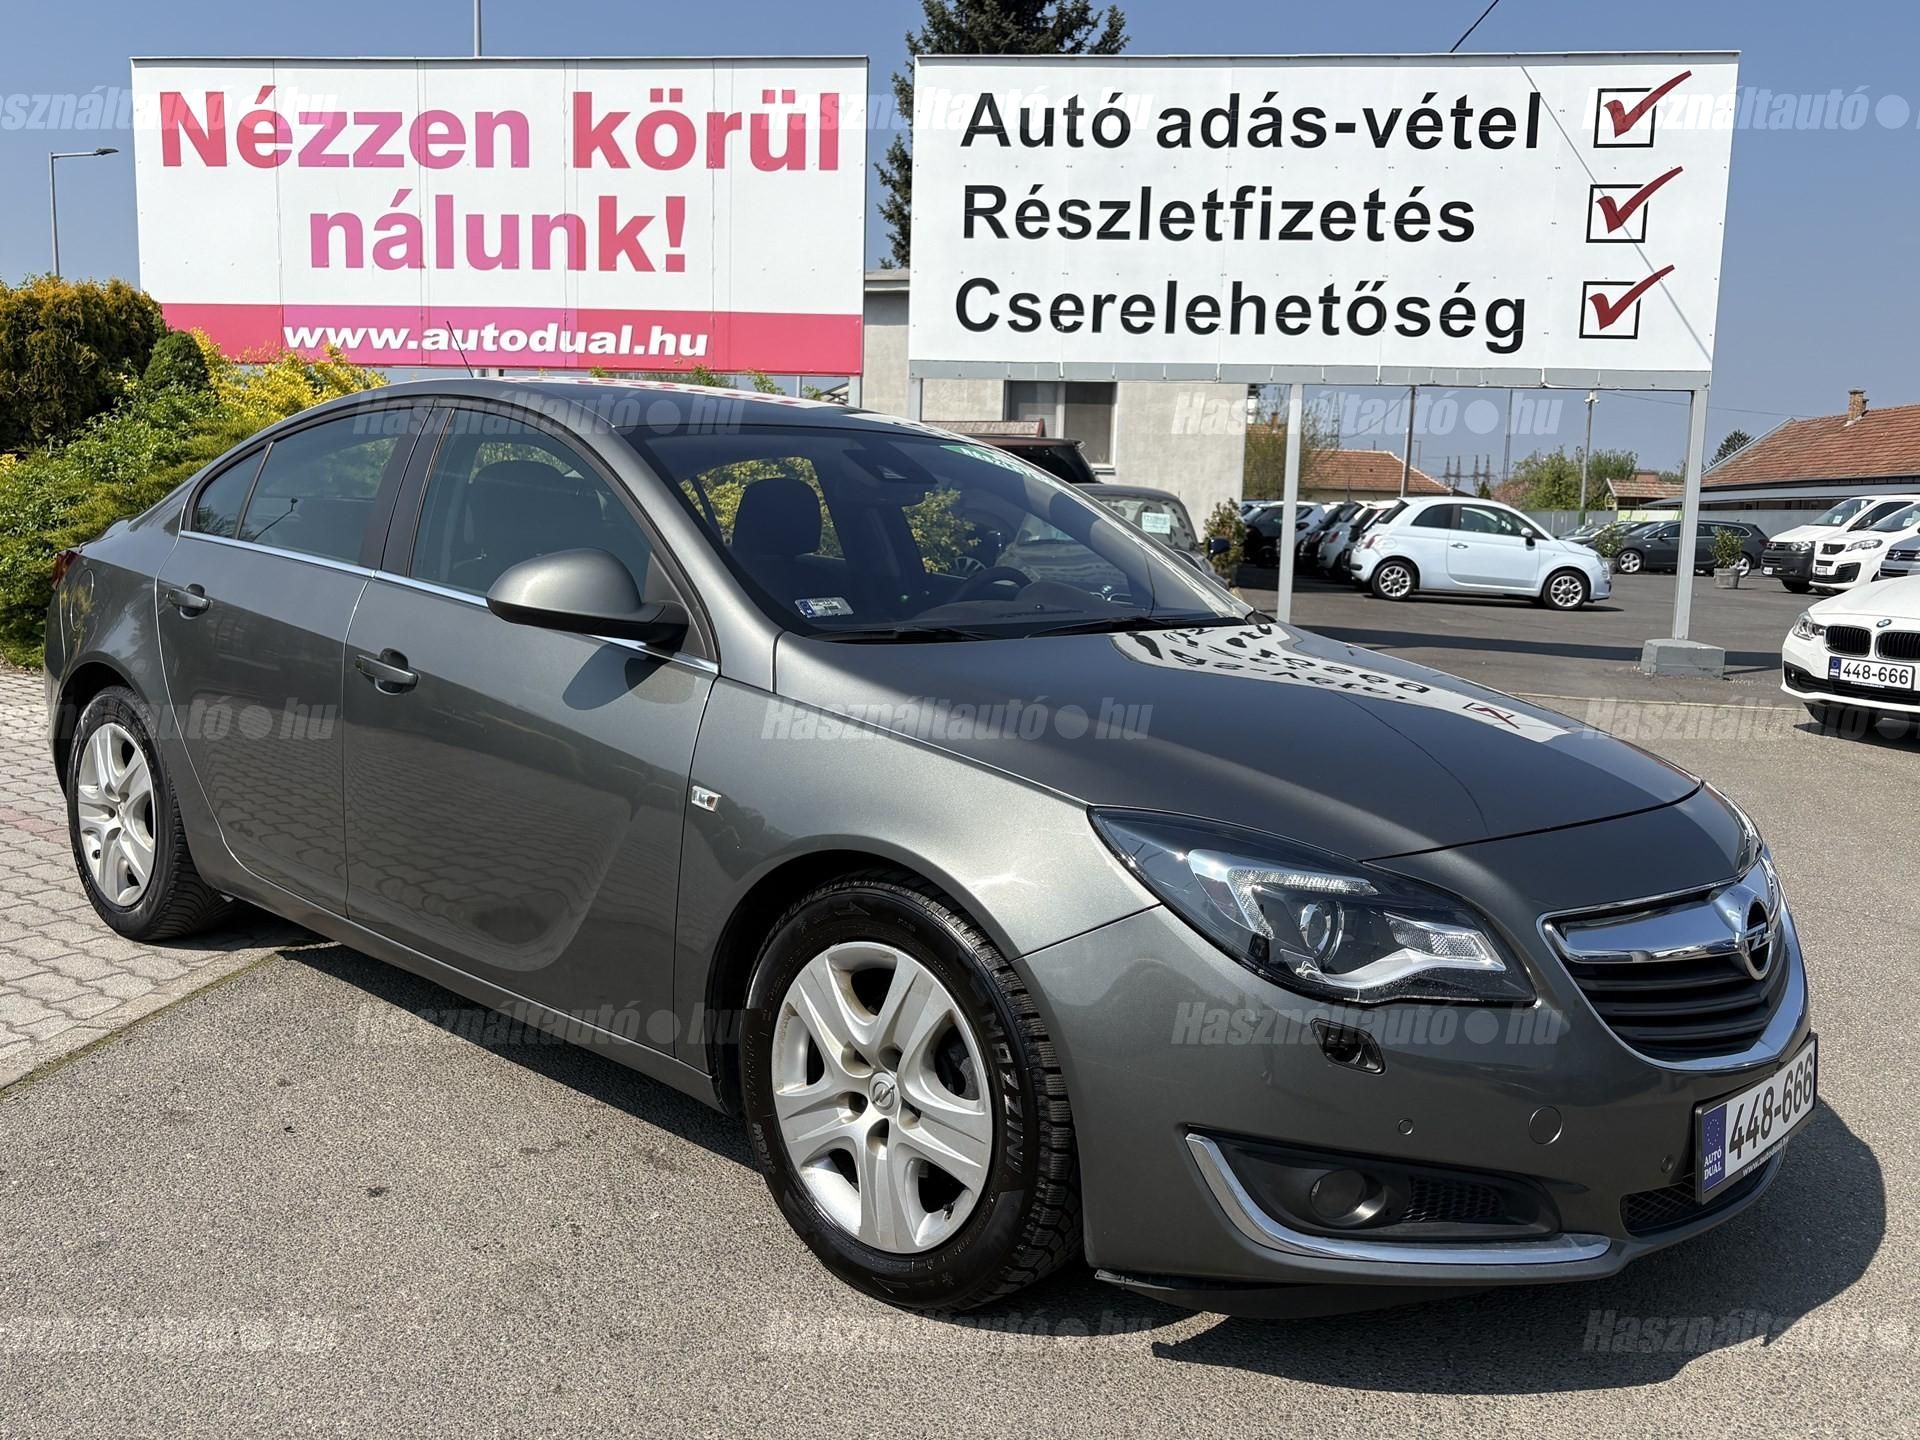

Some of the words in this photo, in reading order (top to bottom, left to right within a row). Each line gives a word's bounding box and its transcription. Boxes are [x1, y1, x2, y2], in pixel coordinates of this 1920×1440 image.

[159, 85, 530, 170] Nézzen
[572, 88, 840, 172] körül
[960, 92, 1131, 149] Autó
[1156, 91, 1541, 150] adás-vétel
[310, 188, 686, 273] nálunk!
[963, 184, 1475, 243] Részletfizetés
[284, 323, 708, 356] www.autodual.hu
[955, 277, 1525, 354] Cserelehetőség
[1842, 661, 1909, 685] 448-666
[1728, 1052, 1814, 1160] 448-666
[1703, 1147, 1723, 1168] AUTÓ
[1703, 1164, 1723, 1181] DUAL
